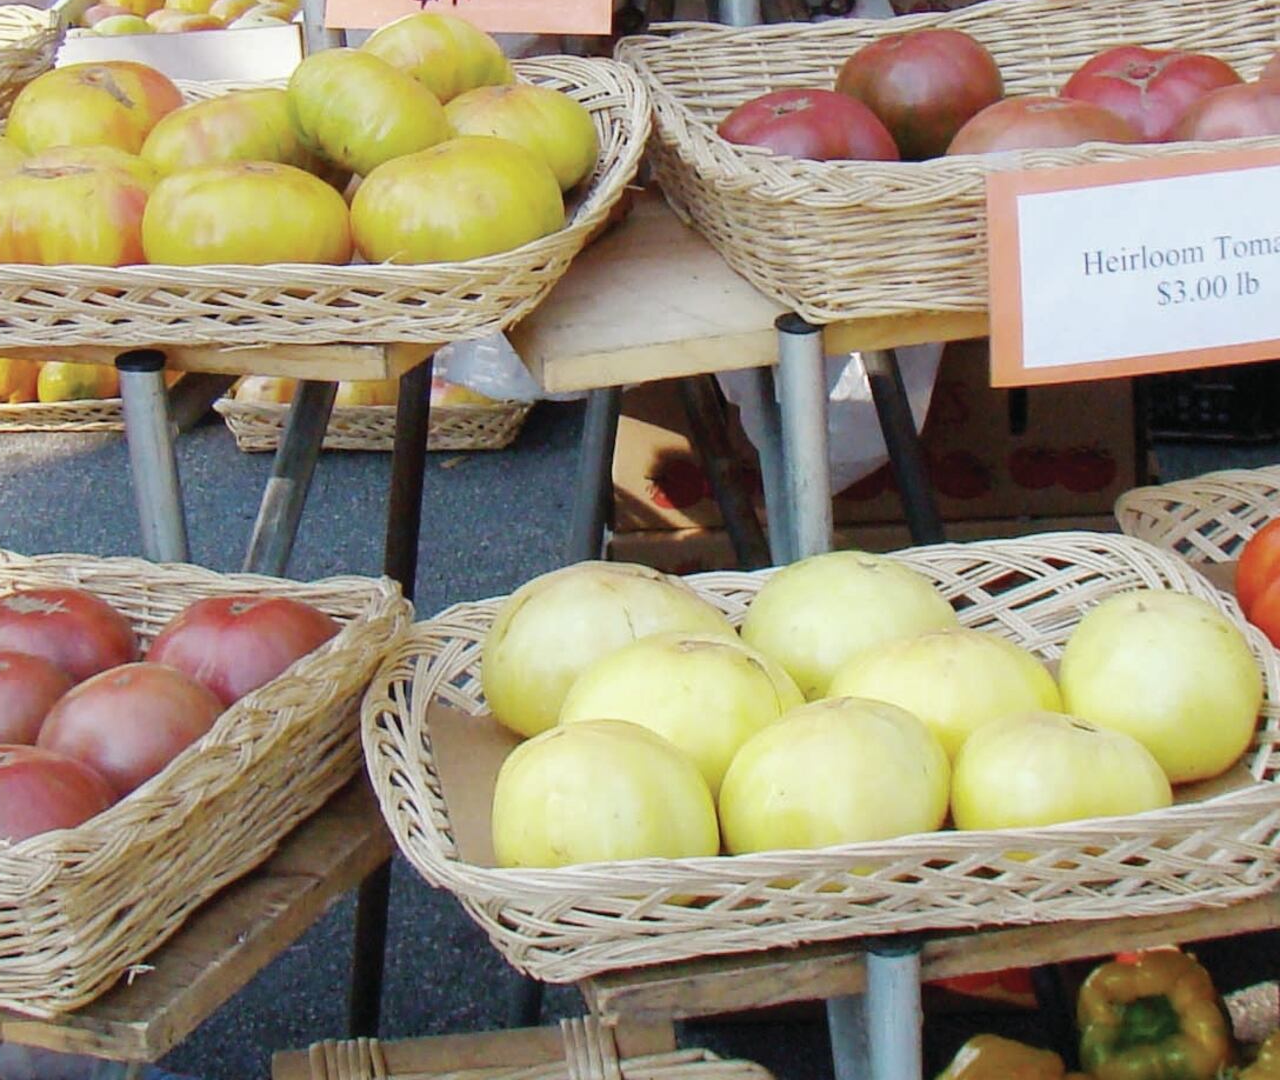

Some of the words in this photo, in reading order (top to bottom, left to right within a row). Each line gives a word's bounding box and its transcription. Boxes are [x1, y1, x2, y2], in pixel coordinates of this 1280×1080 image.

[1082, 240, 1205, 277] Heirloom
[1156, 274, 1228, 307] $3.00
[1236, 270, 1261, 296] lb
